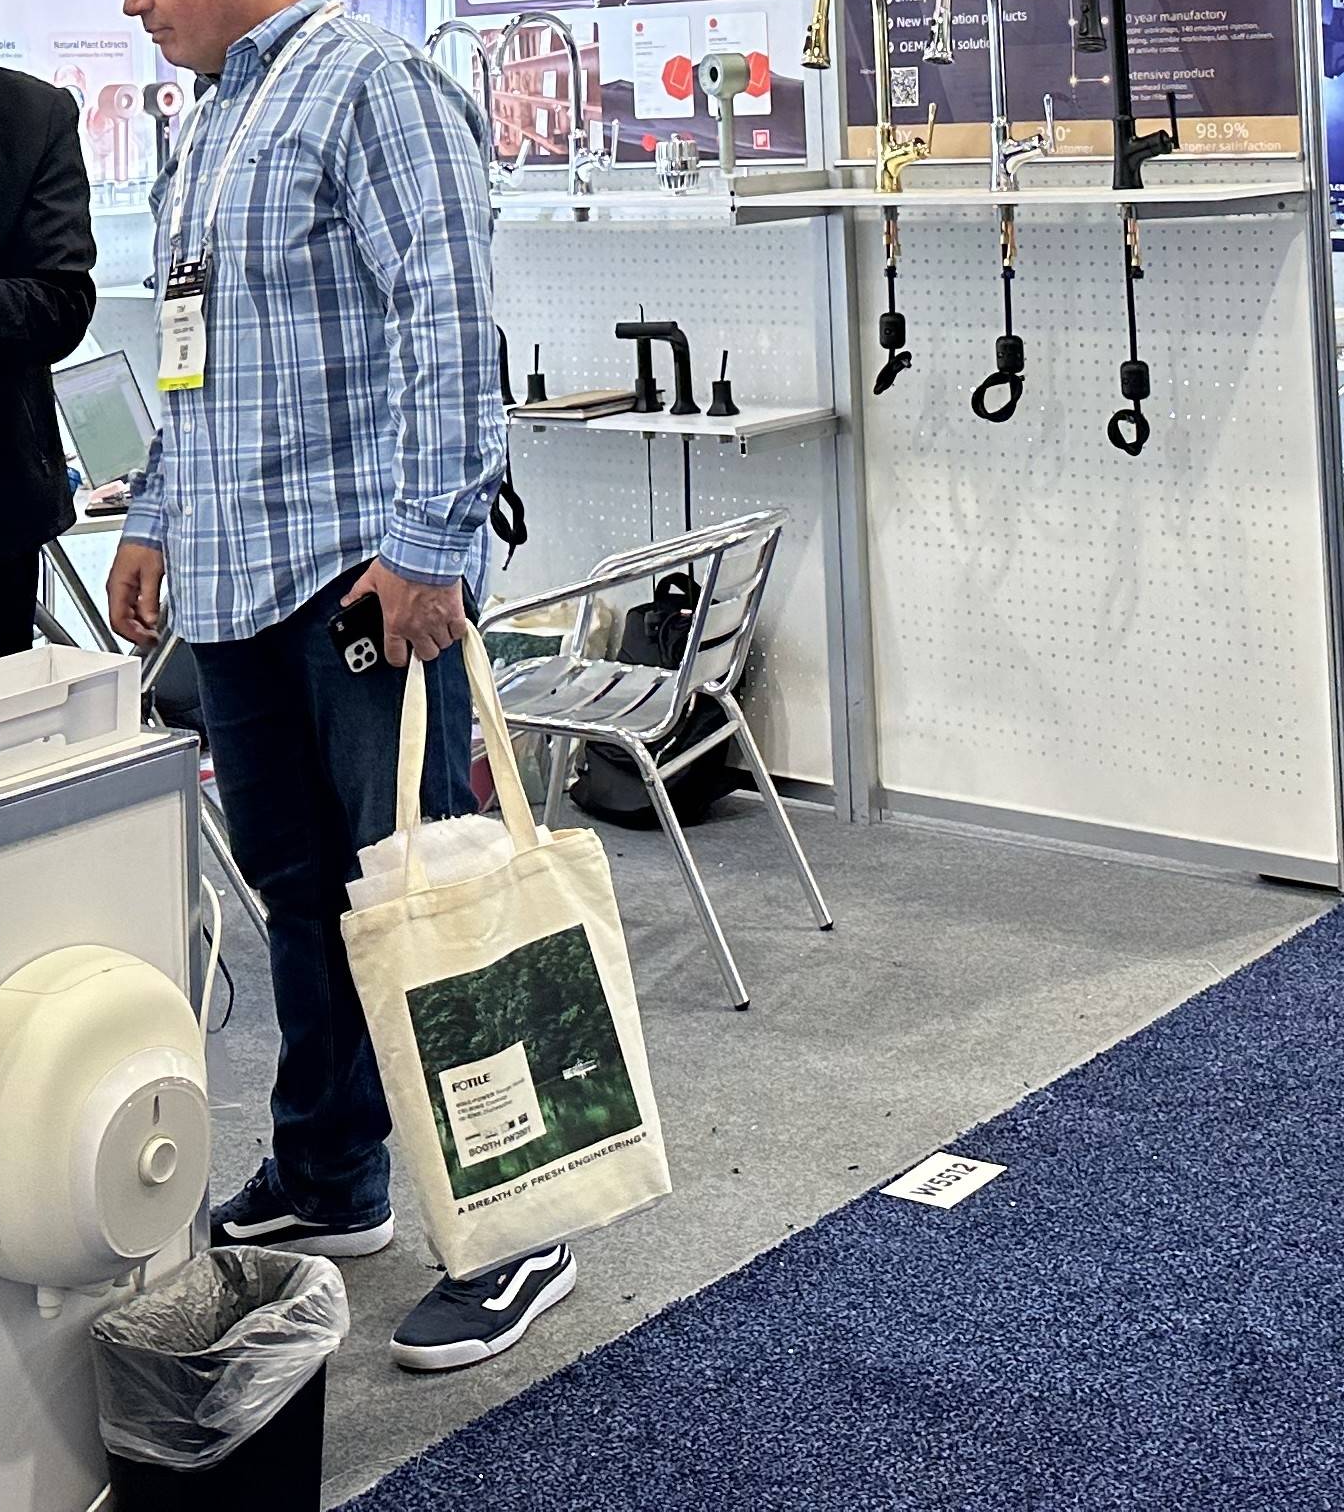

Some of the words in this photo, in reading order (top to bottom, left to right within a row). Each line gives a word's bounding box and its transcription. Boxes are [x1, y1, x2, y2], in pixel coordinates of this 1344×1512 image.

[896, 16, 921, 29] New
[1133, 12, 1158, 25] year
[1159, 8, 1228, 23] manufactory
[1128, 70, 1171, 81] xtensive
[1172, 67, 1216, 81] product
[1195, 122, 1250, 139] 98.9%
[1218, 140, 1282, 152] satisfaction
[451, 1072, 491, 1093] FOTILE
[468, 1139, 502, 1158] BOOTH
[908, 1162, 979, 1197] W5512
[457, 1205, 466, 1216] A
[467, 1189, 514, 1214] BREATH
[514, 1182, 529, 1195] OF
[530, 1166, 567, 1189] FRESH
